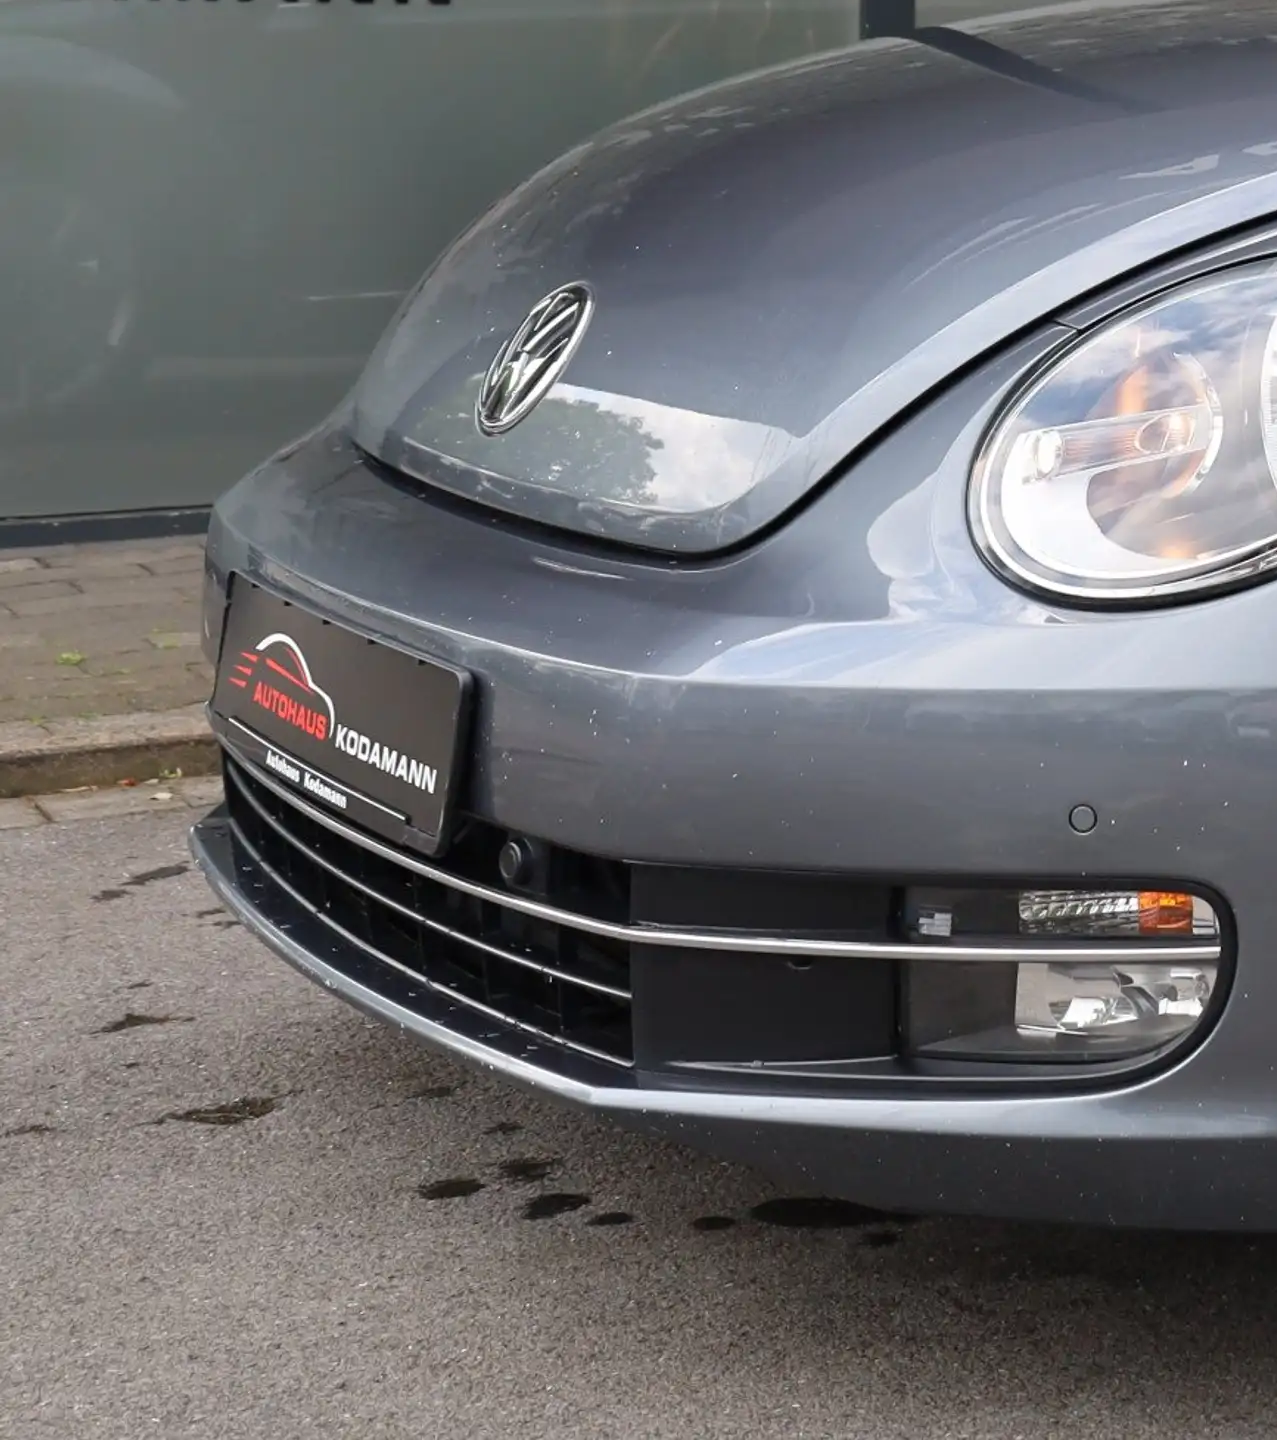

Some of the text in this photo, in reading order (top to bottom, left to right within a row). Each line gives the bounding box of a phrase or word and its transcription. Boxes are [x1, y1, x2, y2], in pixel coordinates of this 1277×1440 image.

[253, 681, 438, 795] AUTOHAUS KODAMANN
[265, 750, 347, 809] Autohaus Kodamann
